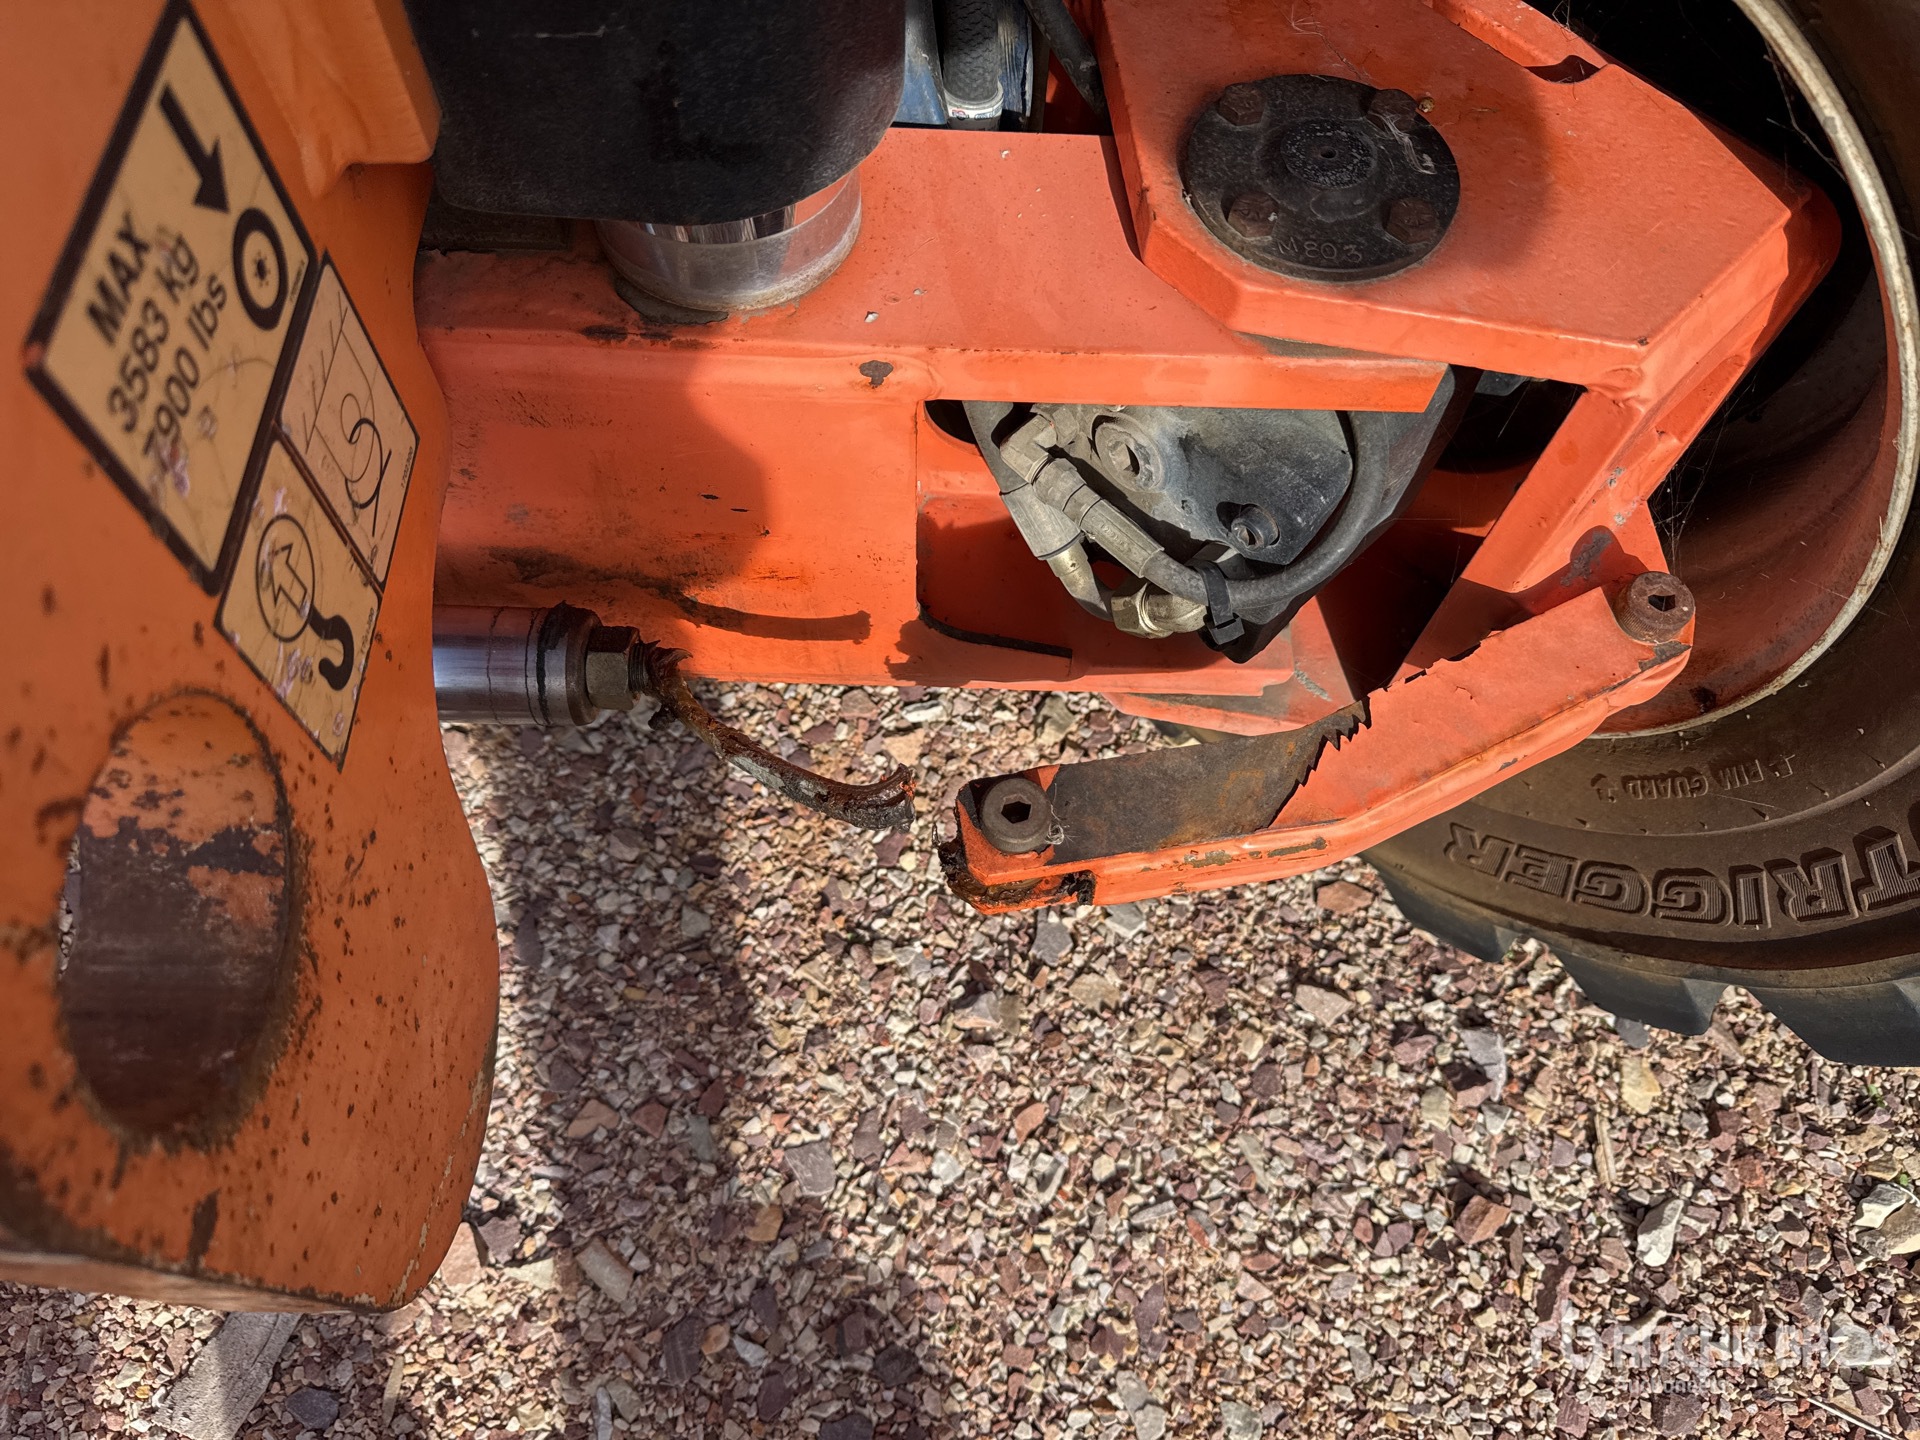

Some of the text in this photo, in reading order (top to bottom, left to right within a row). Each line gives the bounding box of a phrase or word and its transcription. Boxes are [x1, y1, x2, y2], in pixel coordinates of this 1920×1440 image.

[86, 209, 151, 346] MAX
[108, 233, 199, 433] 3583 kg
[142, 272, 227, 473] 7900 lbs
[1621, 756, 1764, 799] RIM GUARD
[1443, 822, 1920, 930] TRIGGER
